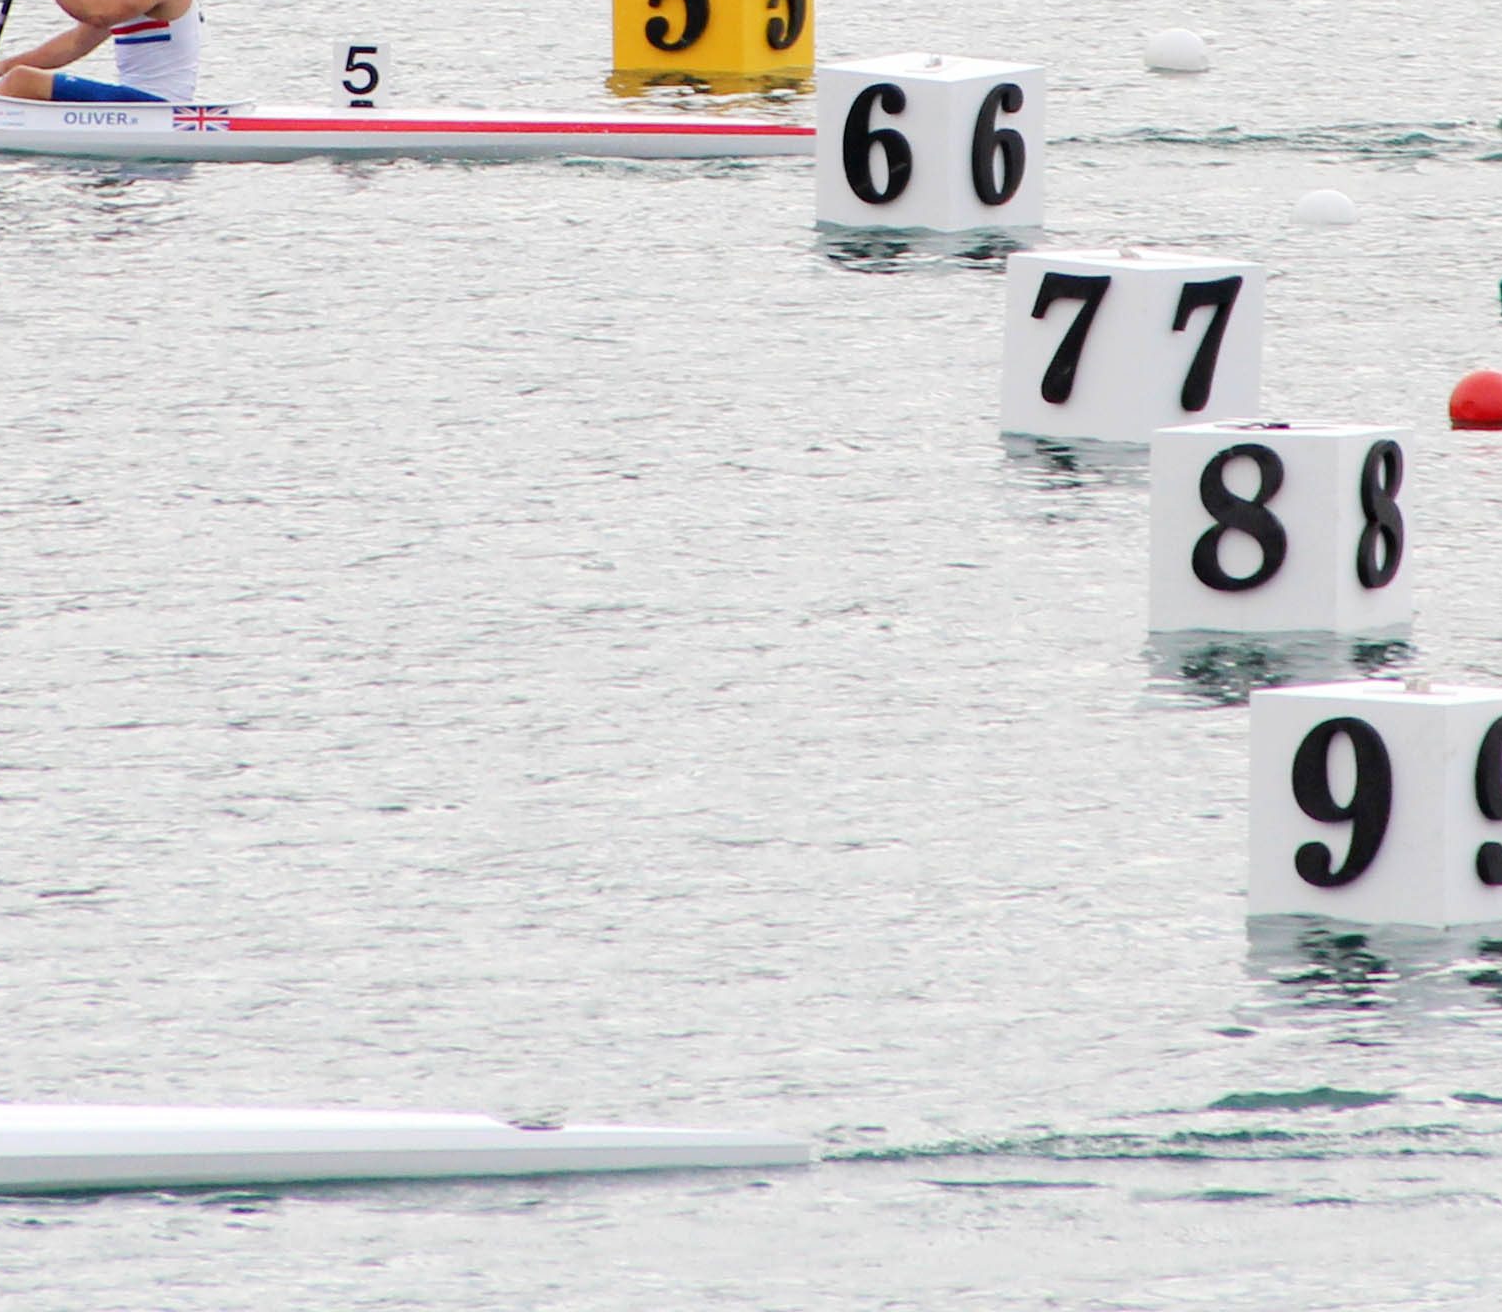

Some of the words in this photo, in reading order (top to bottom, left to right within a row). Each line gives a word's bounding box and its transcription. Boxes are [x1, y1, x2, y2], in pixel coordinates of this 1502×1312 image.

[342, 46, 379, 95] 5
[843, 83, 913, 204] 6
[971, 83, 1026, 206] 6
[1031, 272, 1112, 404] 7
[1172, 276, 1243, 411] 7
[1192, 443, 1287, 592] 8
[1357, 439, 1403, 590] 8
[1292, 717, 1392, 888] 9
